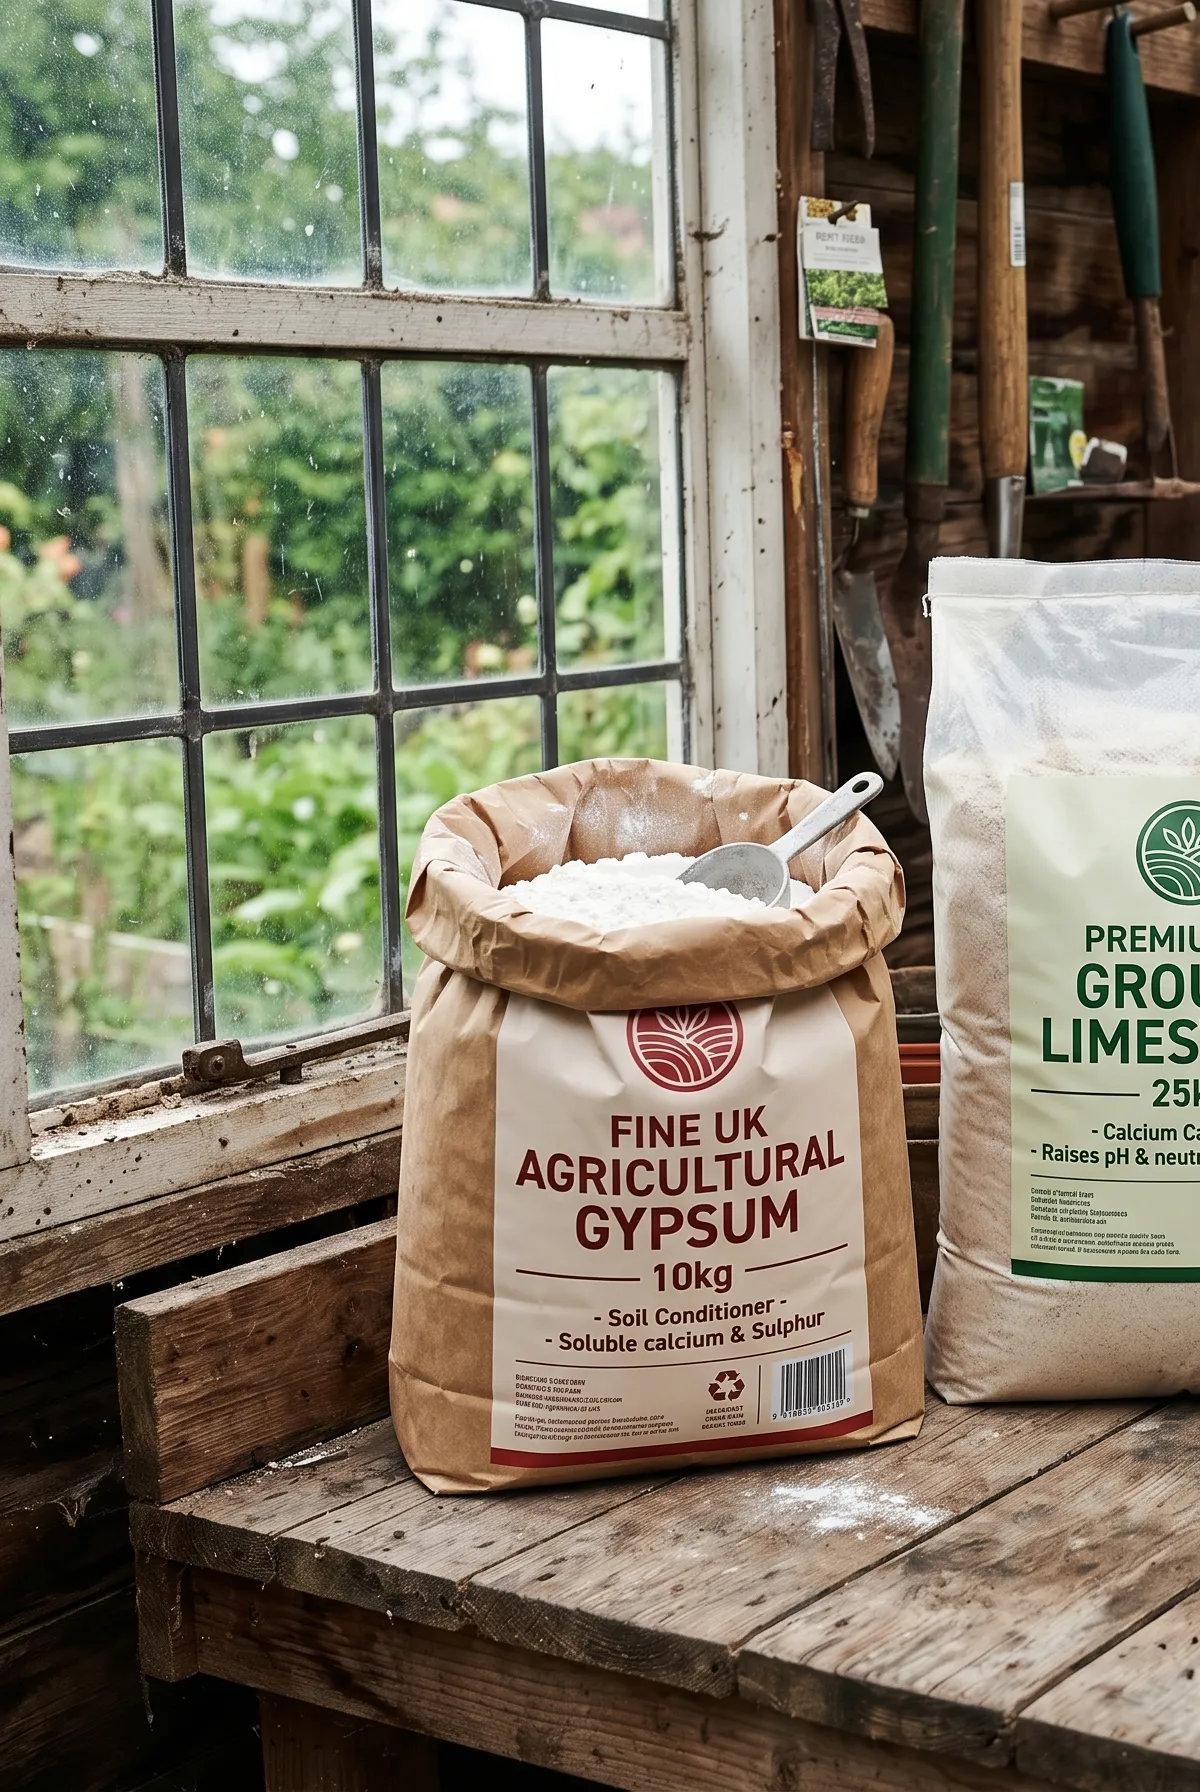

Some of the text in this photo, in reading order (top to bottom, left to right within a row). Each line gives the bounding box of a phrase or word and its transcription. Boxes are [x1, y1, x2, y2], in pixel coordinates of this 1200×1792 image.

[611, 1104, 769, 1149] FINE UK
[1103, 1122, 1178, 1141] Calcium
[515, 1128, 845, 1198] AGRICULTURAL
[1042, 1143, 1100, 1164] Raises
[1105, 1147, 1129, 1169] pH
[1134, 1147, 1150, 1166] &
[575, 1188, 799, 1251] GYPSUM
[653, 1260, 733, 1294] 10kg
[608, 1308, 649, 1327] Soil
[654, 1297, 776, 1327] Conditioner
[559, 1332, 638, 1353] Soluble
[643, 1331, 724, 1352] calcium
[730, 1325, 746, 1344] &
[751, 1310, 826, 1341] Sulphur
